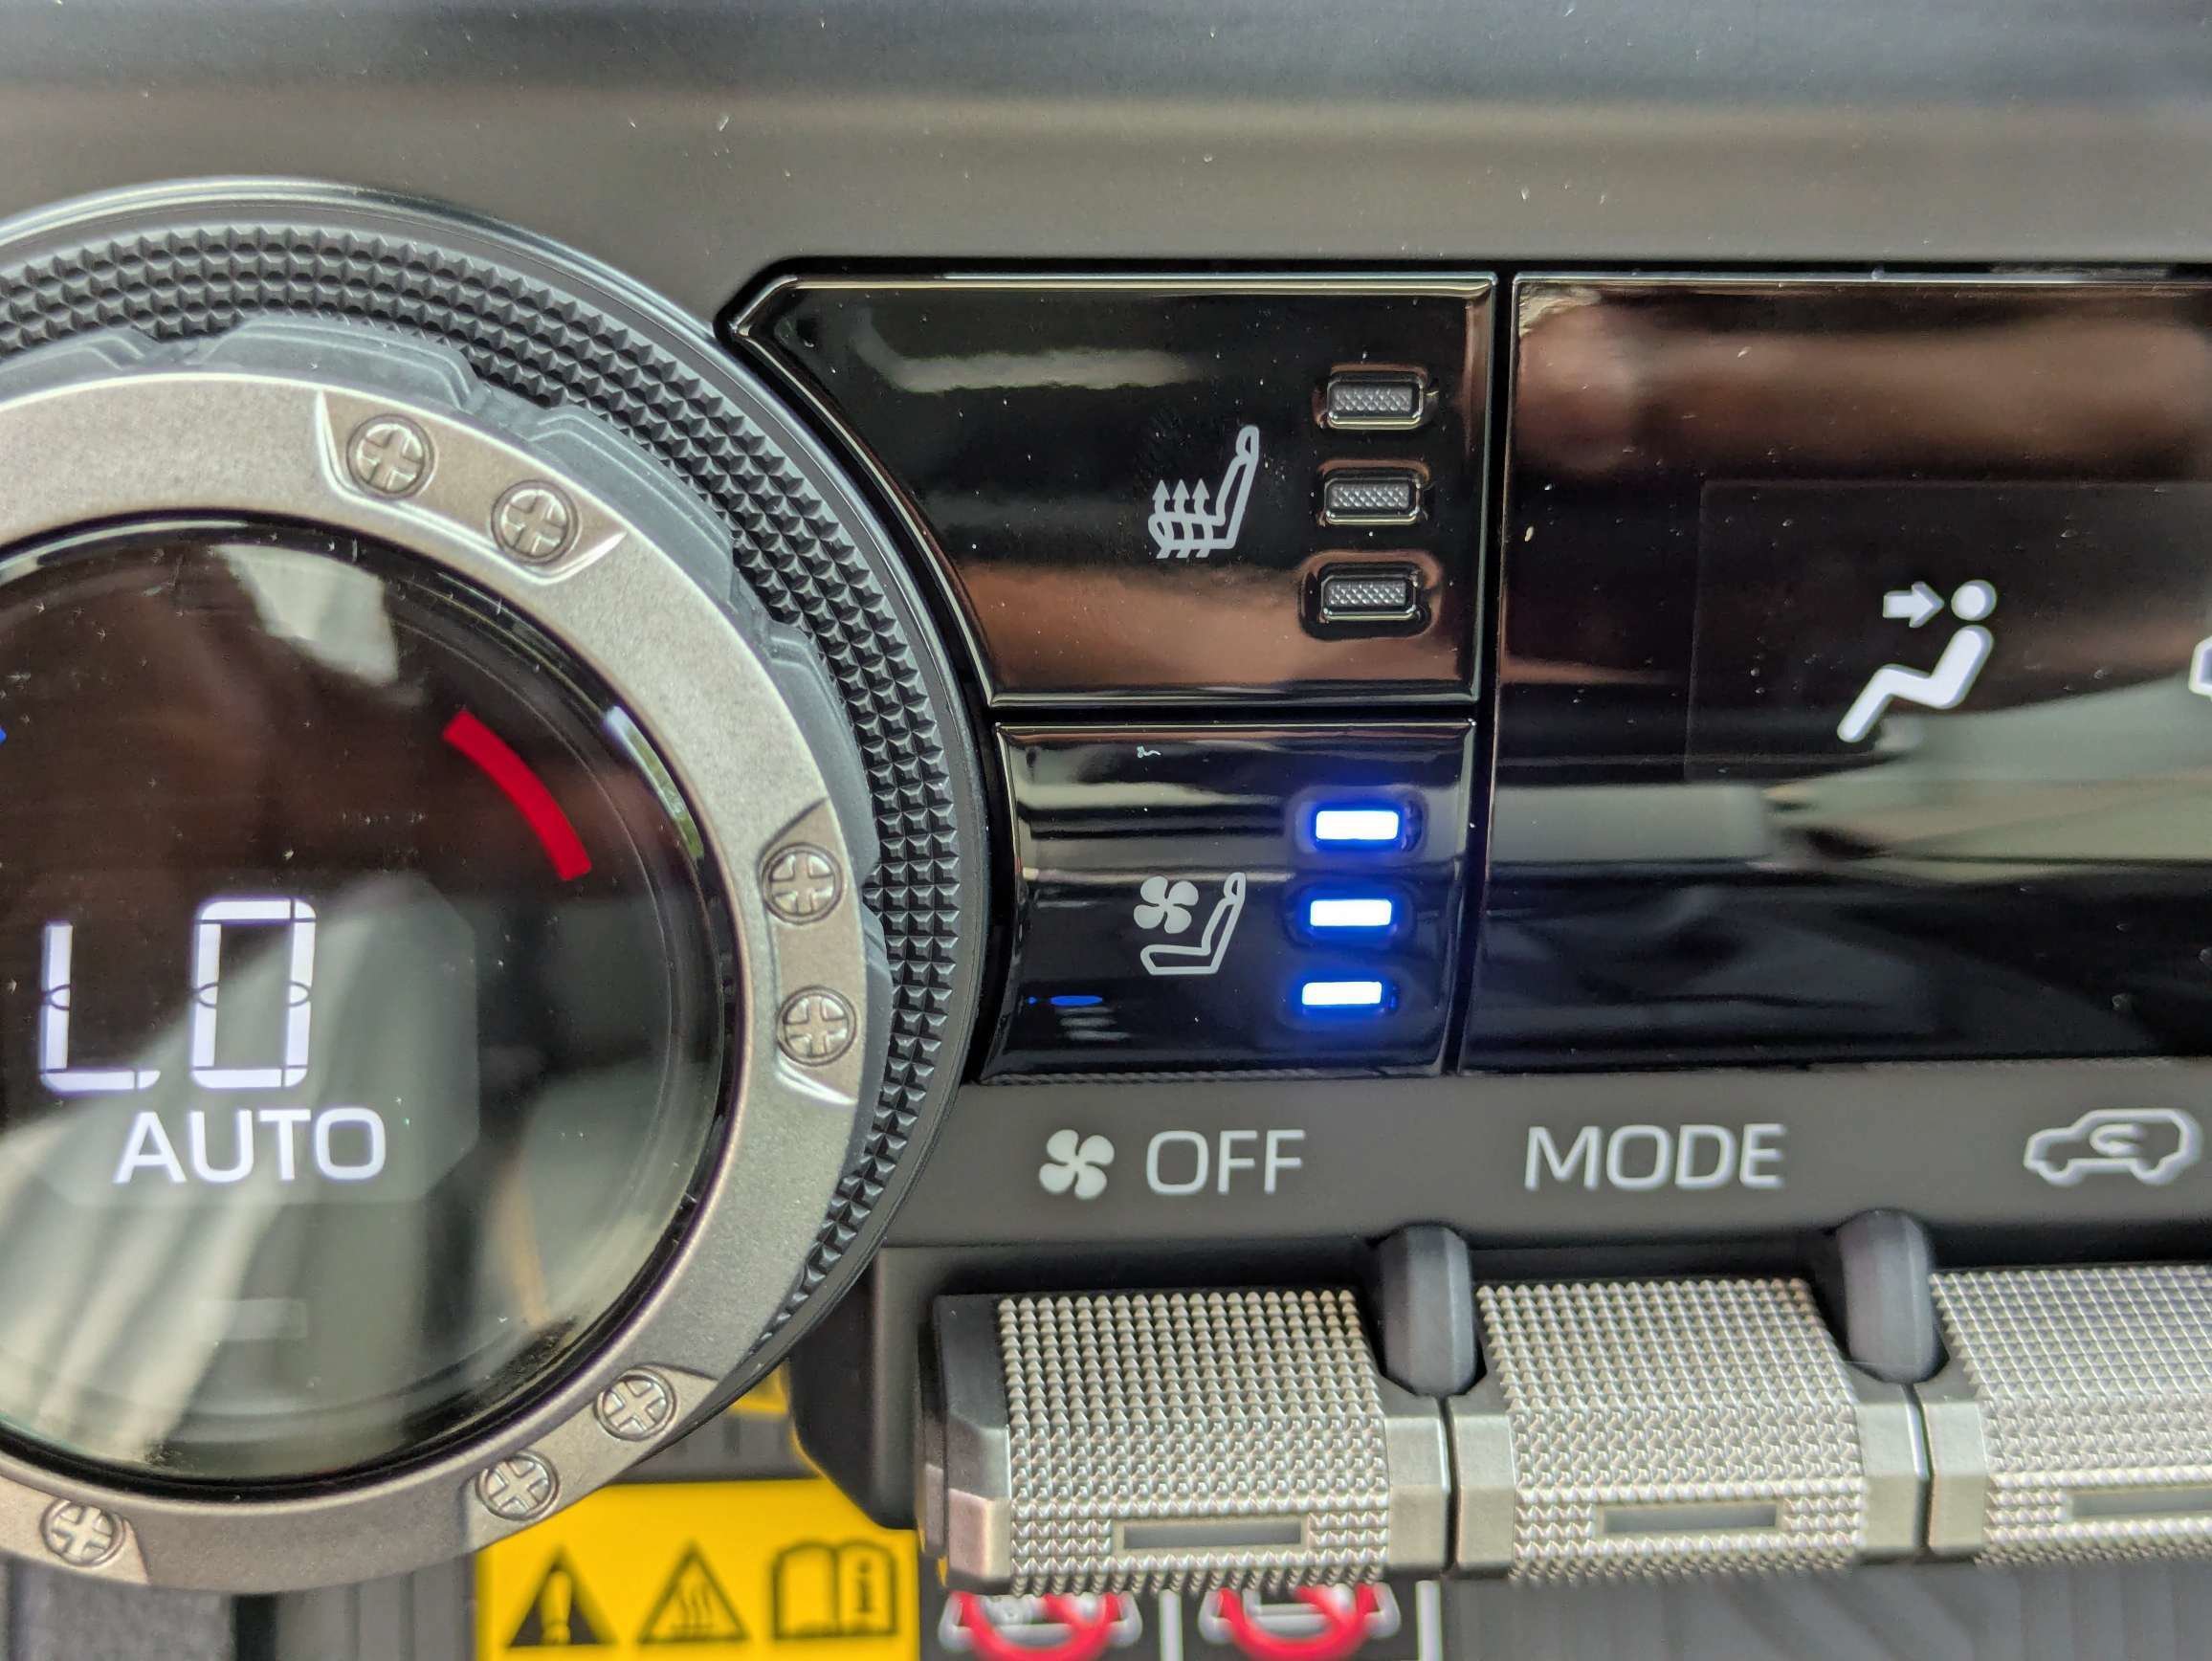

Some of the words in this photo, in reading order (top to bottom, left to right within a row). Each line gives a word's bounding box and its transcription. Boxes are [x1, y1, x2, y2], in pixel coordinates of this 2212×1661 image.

[112, 1106, 387, 1185] AUTO
[1145, 1128, 1307, 1195] OFF
[1523, 1122, 1788, 1190] MODE
